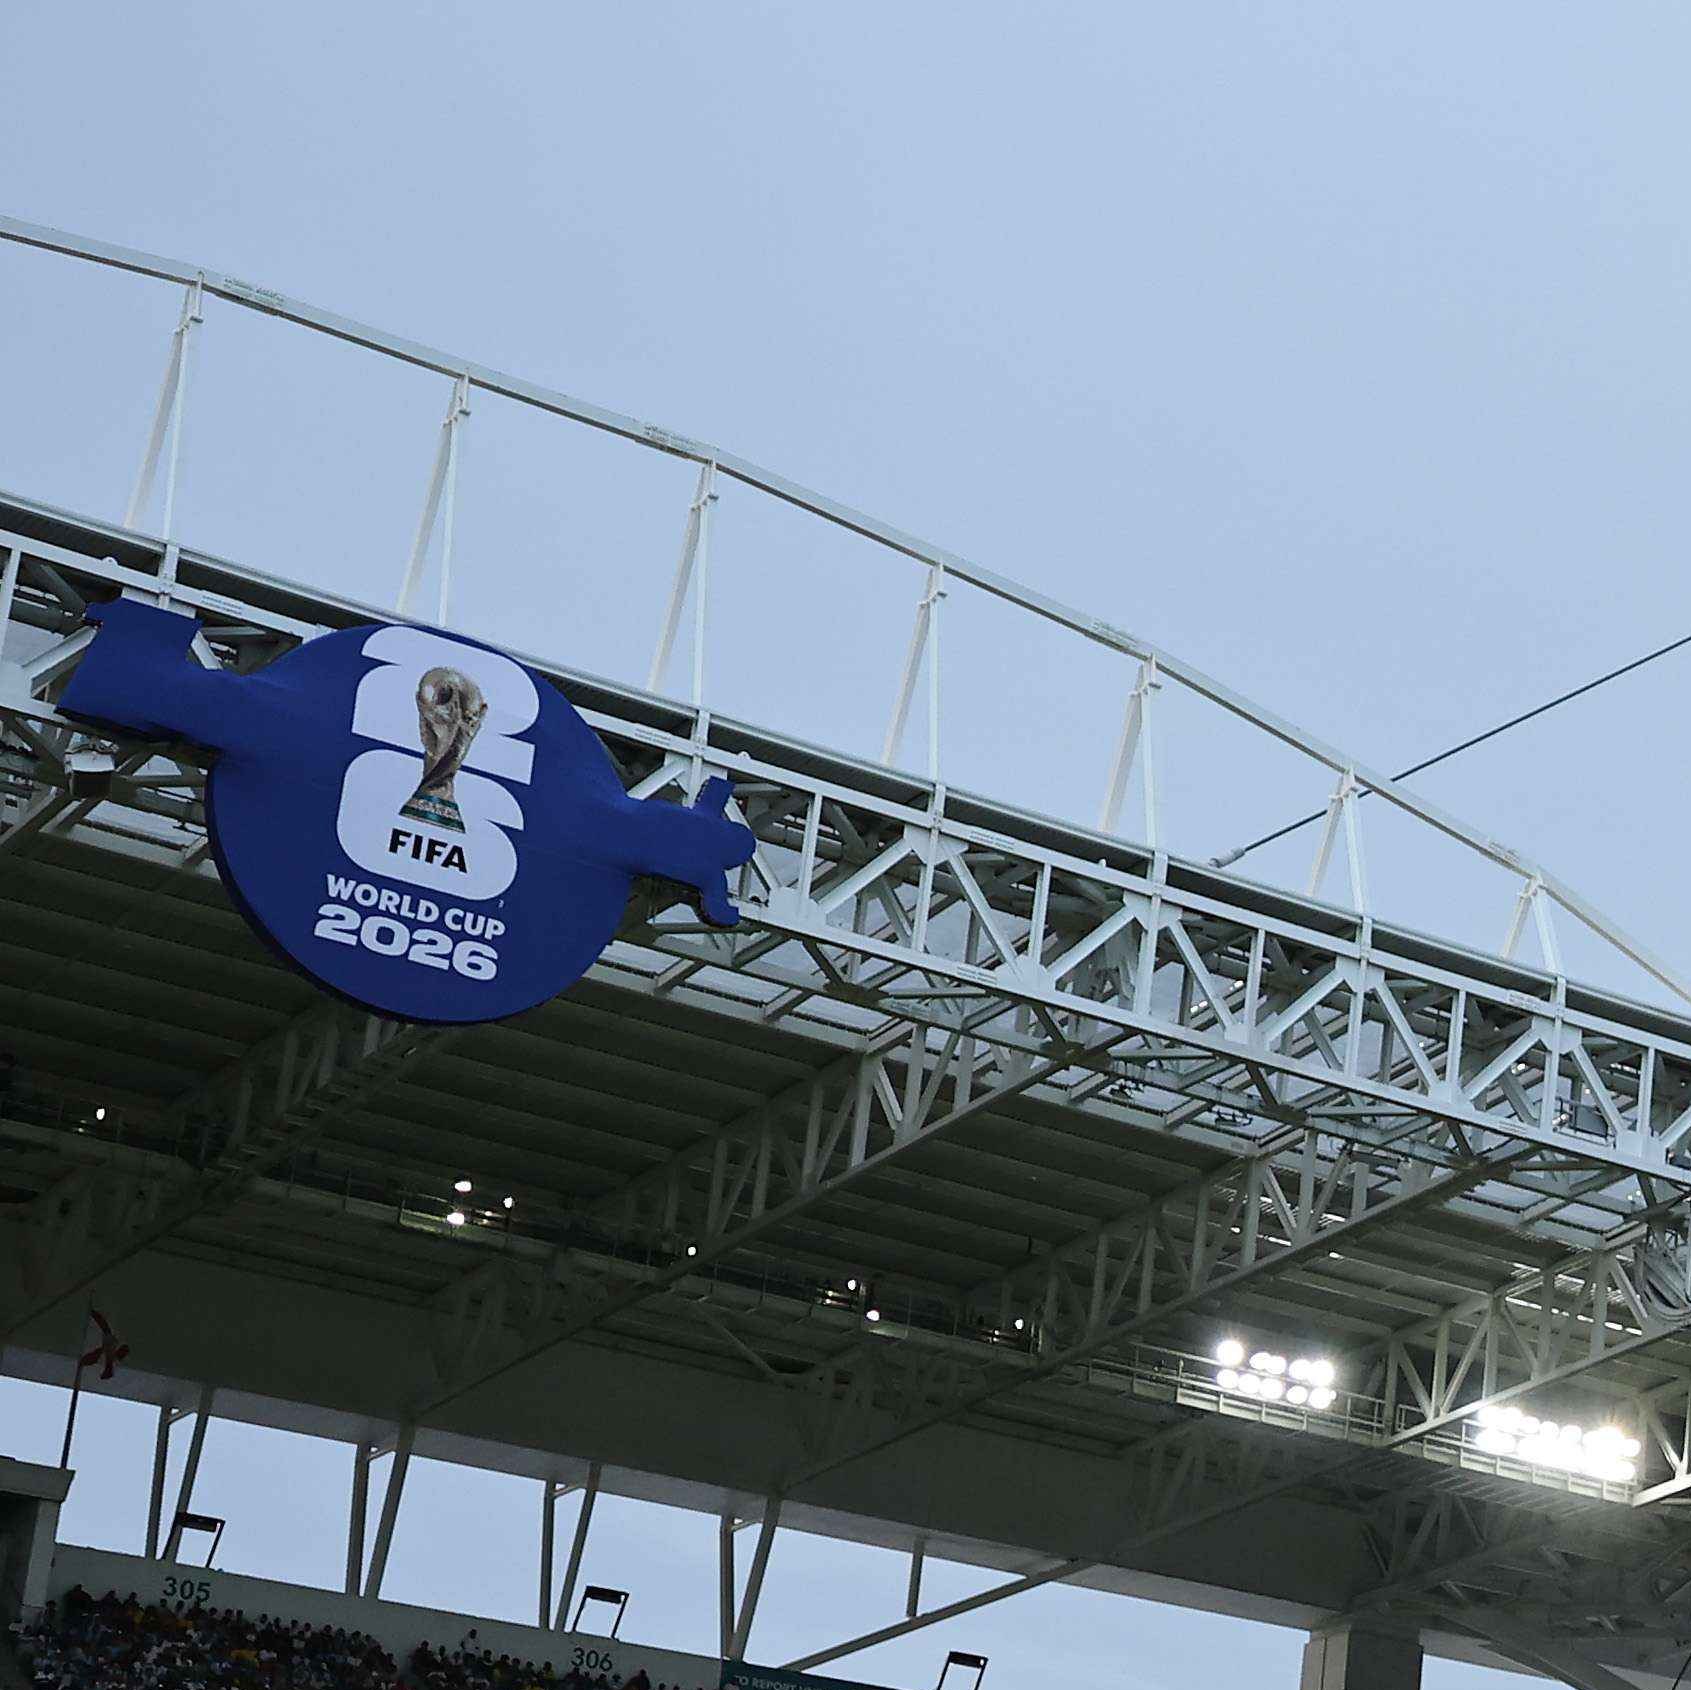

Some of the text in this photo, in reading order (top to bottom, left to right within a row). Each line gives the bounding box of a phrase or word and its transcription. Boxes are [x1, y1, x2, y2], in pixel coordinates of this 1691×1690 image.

[388, 828, 468, 874] FIFA
[326, 874, 506, 940] WORLD CUP
[314, 903, 499, 981] 2026
[163, 1576, 212, 1603] 305
[570, 1647, 614, 1672] 306
